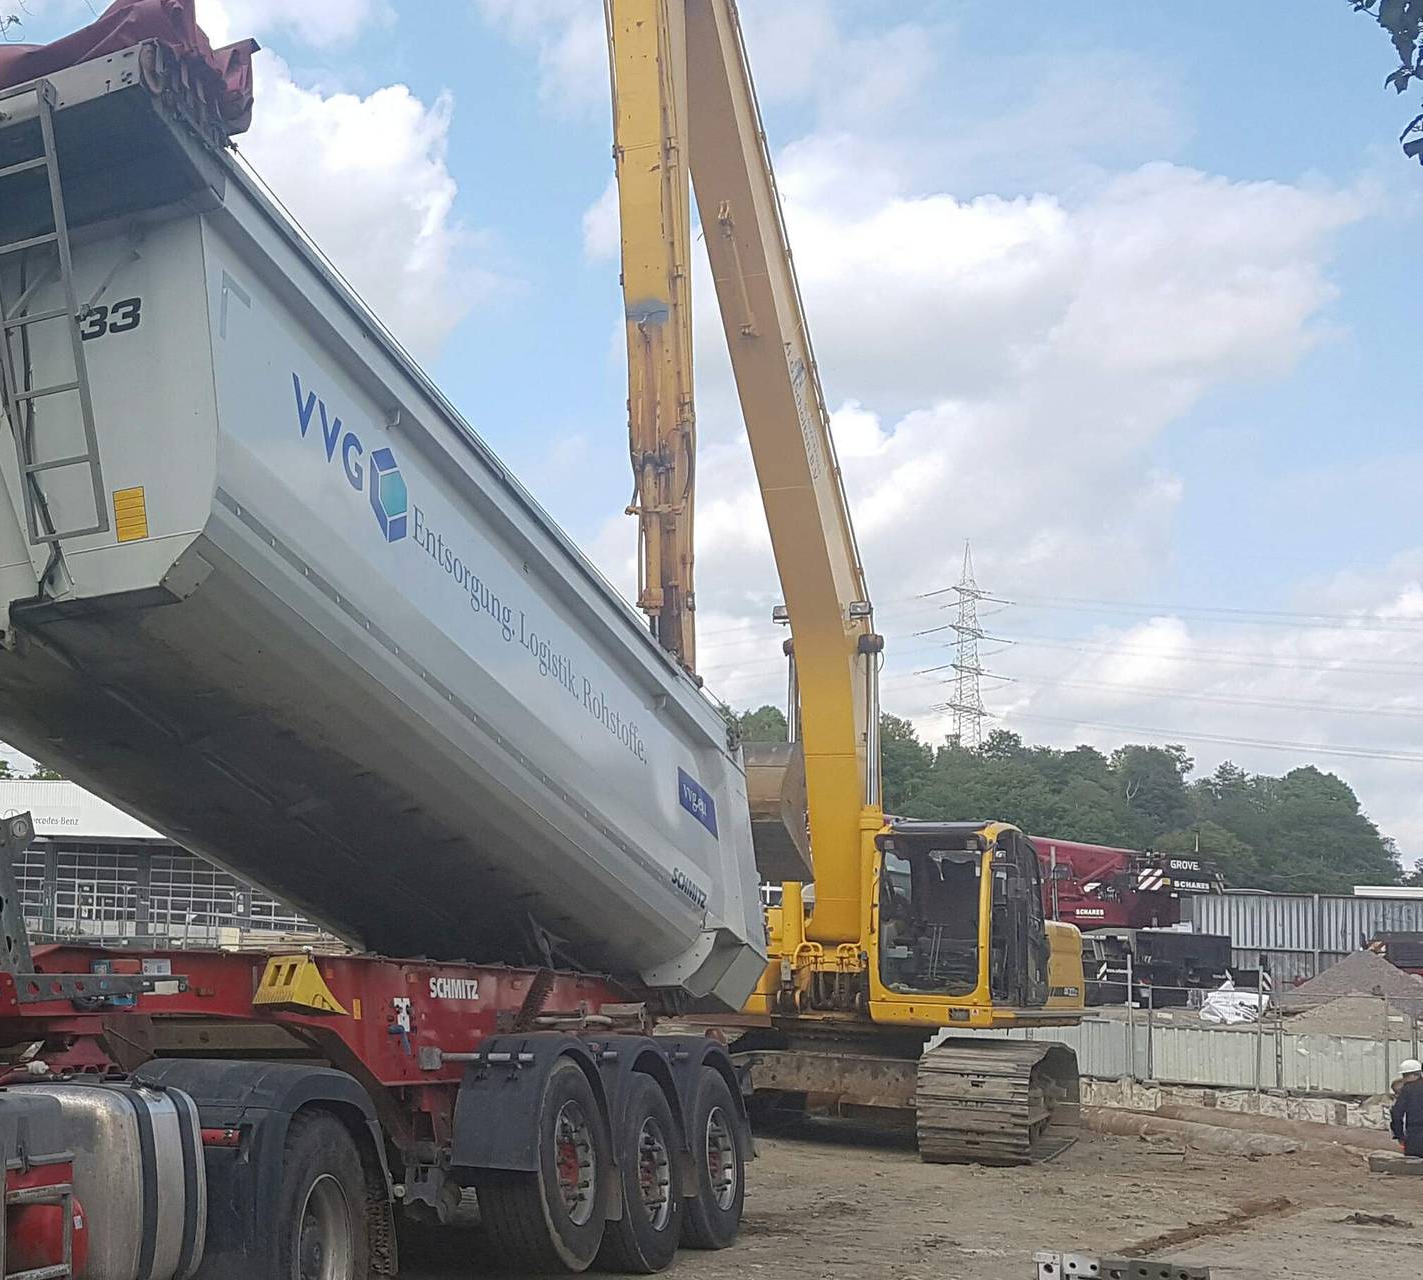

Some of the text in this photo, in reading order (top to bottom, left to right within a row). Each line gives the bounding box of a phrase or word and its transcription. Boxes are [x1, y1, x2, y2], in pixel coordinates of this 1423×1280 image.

[78, 297, 141, 341] 33
[292, 372, 363, 491] VVG
[582, 675, 648, 764] Rohstoffe.
[1170, 860, 1201, 870] GROVE
[671, 867, 707, 909] SCHMITZ
[429, 977, 479, 1000] SCHMITZ
